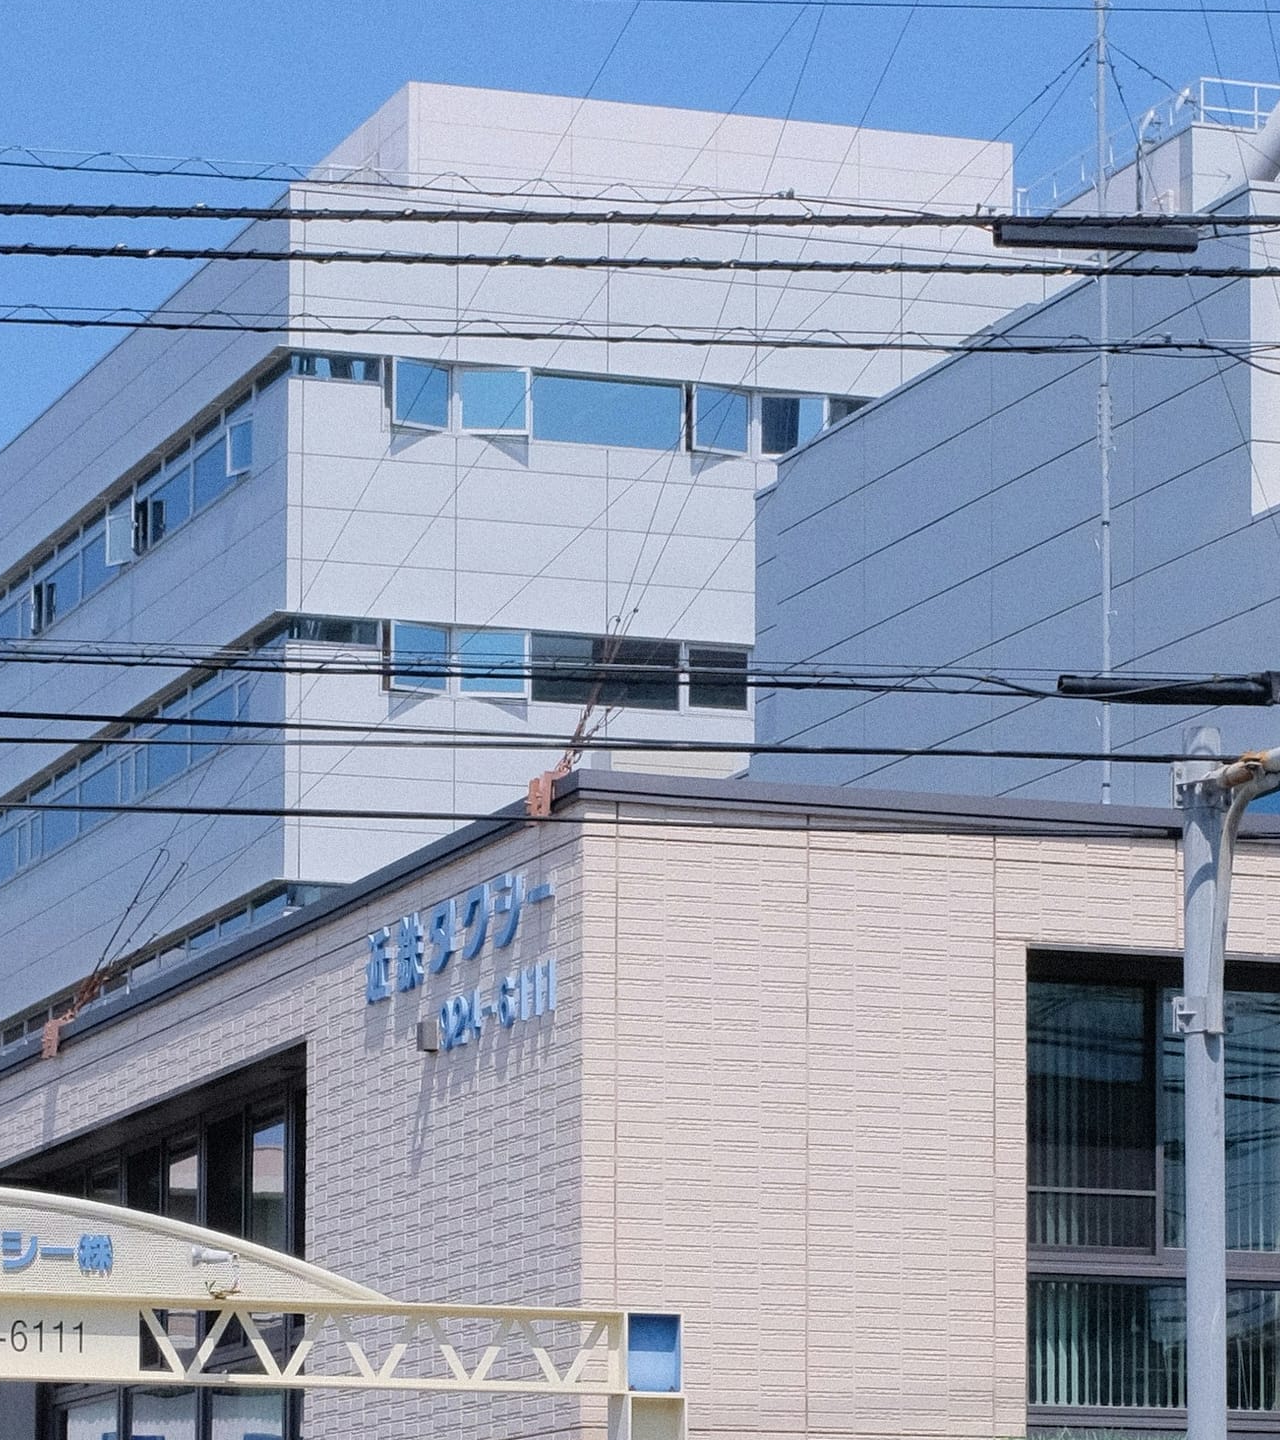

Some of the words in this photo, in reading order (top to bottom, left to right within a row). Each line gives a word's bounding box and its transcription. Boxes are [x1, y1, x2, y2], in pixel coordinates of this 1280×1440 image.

[366, 873, 555, 1004] 近鉄タクシー
